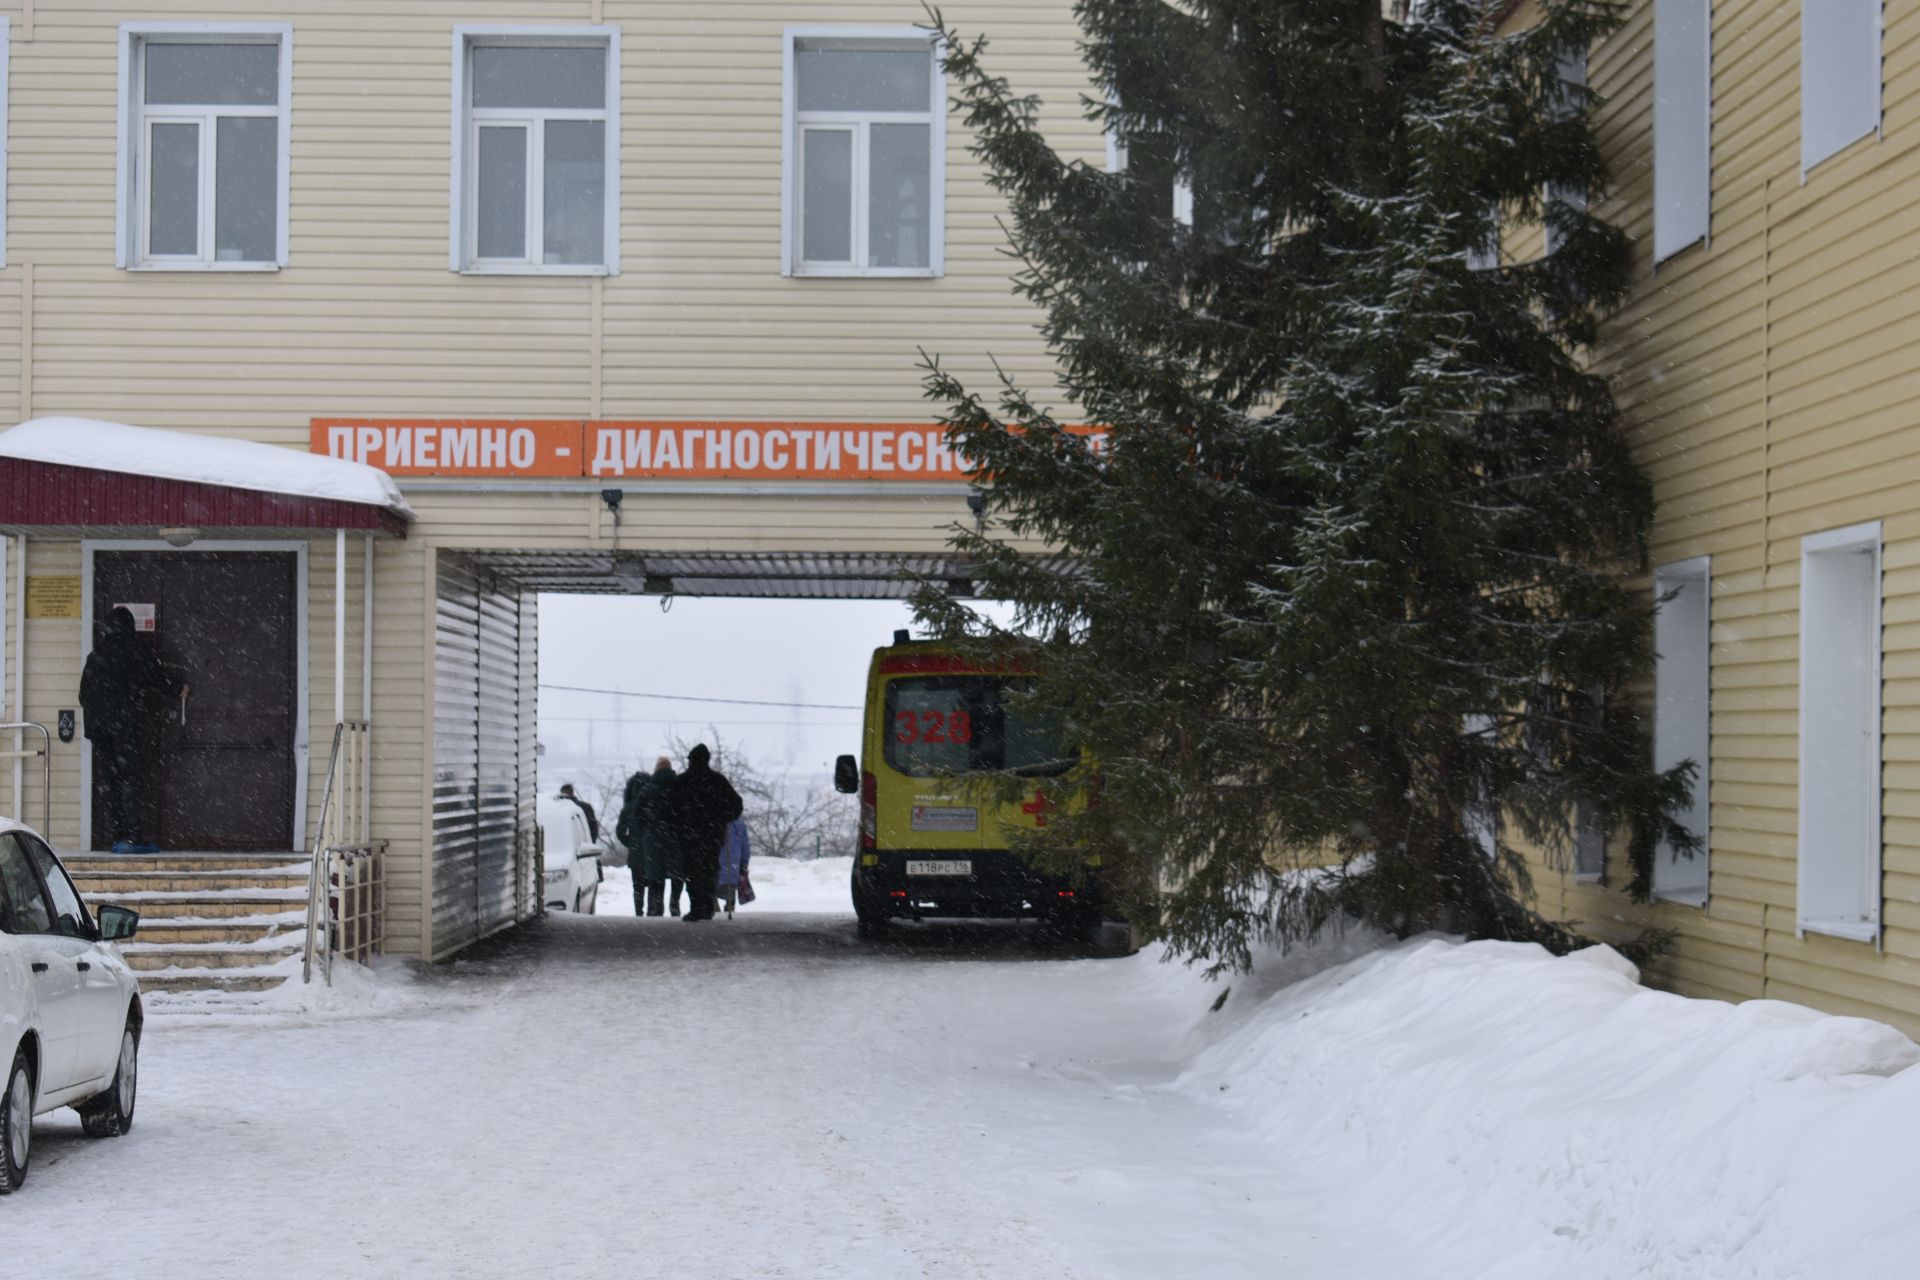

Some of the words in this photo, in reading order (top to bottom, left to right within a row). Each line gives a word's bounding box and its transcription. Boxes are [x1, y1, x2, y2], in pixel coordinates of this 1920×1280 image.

[328, 427, 535, 469] ПРИЕМНО
[592, 428, 992, 475] ДИАГНОСТИЧЕСКО
[896, 710, 971, 744] 328
